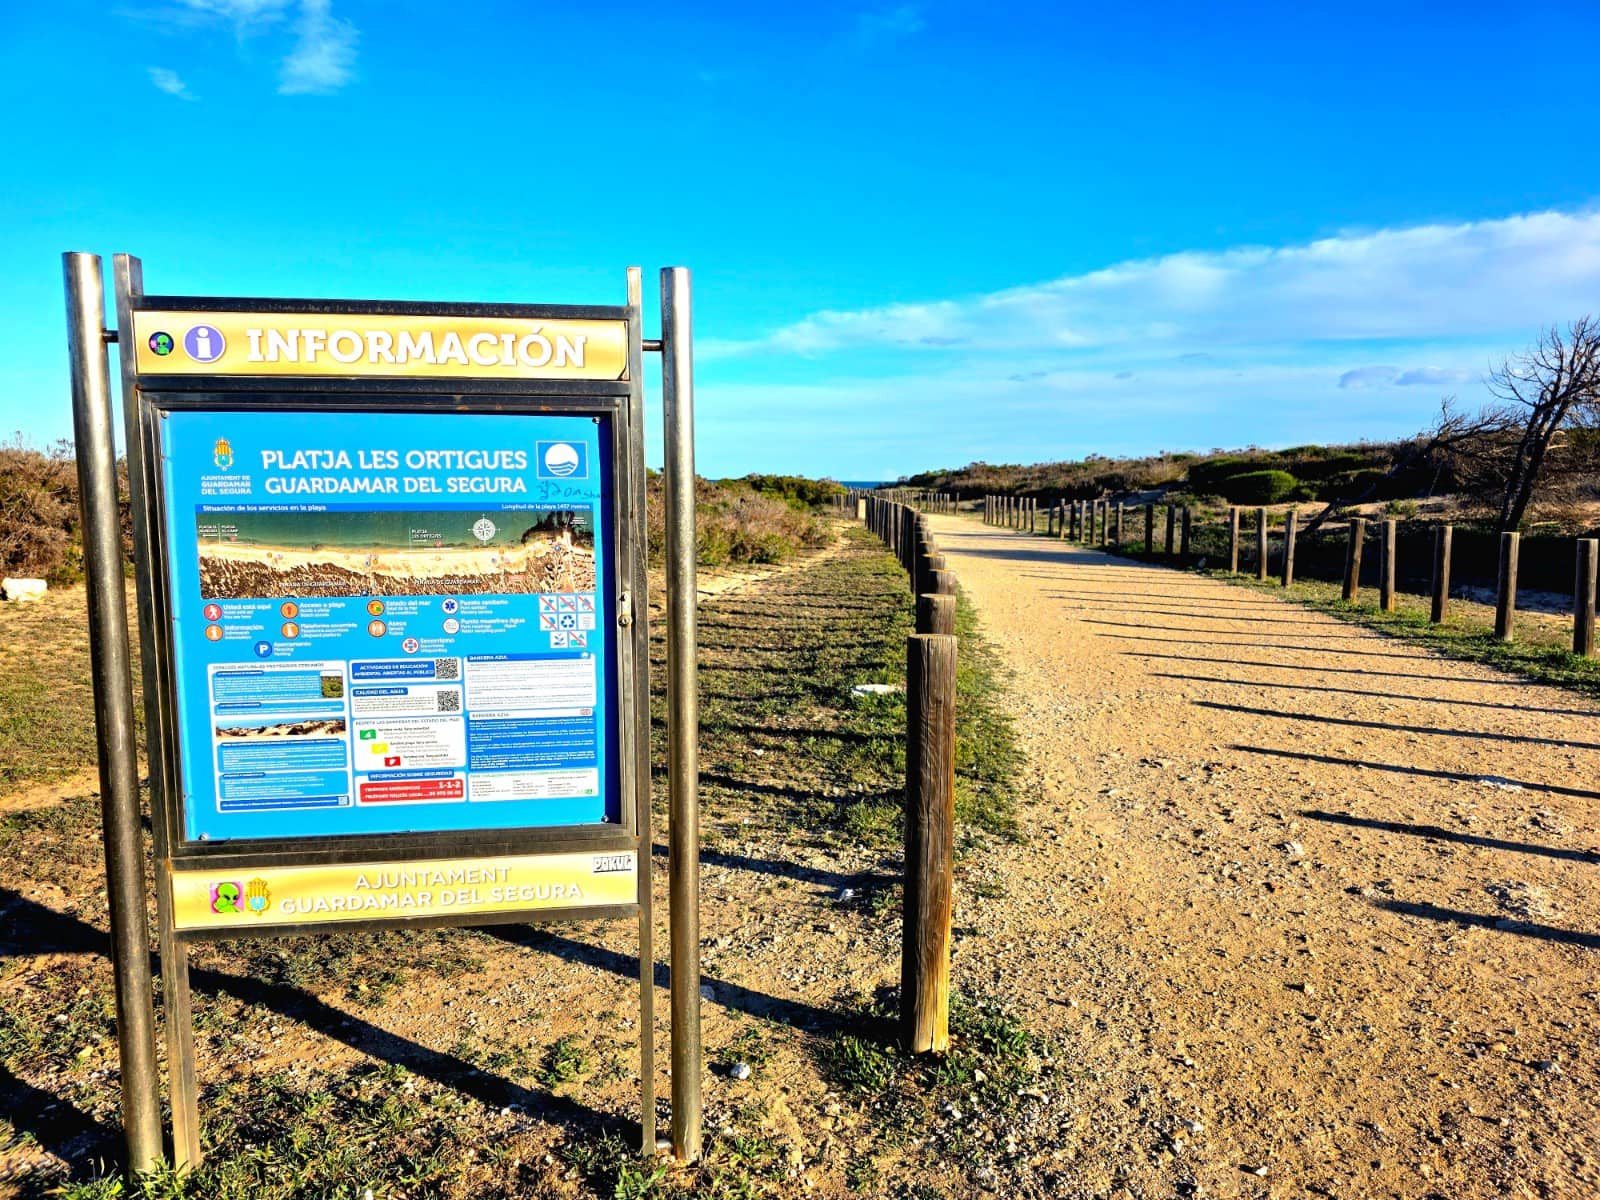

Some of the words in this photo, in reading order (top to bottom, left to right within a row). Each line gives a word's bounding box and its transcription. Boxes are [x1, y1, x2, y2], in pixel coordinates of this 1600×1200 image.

[246, 326, 588, 369] INFORMACIÓN
[261, 450, 353, 469] PLATJA
[357, 450, 399, 470] LES
[405, 450, 528, 470] ORTIGUES
[264, 477, 398, 494] GUARDAMAR
[403, 477, 442, 494] DEL
[447, 477, 527, 494] SEGURA
[202, 504, 236, 512] Situación
[308, 504, 327, 512] playa
[502, 503, 527, 511] Longitud
[541, 503, 557, 511] playa
[438, 780, 461, 788] 1-1-2
[354, 866, 512, 890] AJUNTAMENT
[279, 890, 433, 916] GUARDAMAR
[436, 888, 484, 909] DEL
[487, 882, 584, 904] SEGURA
